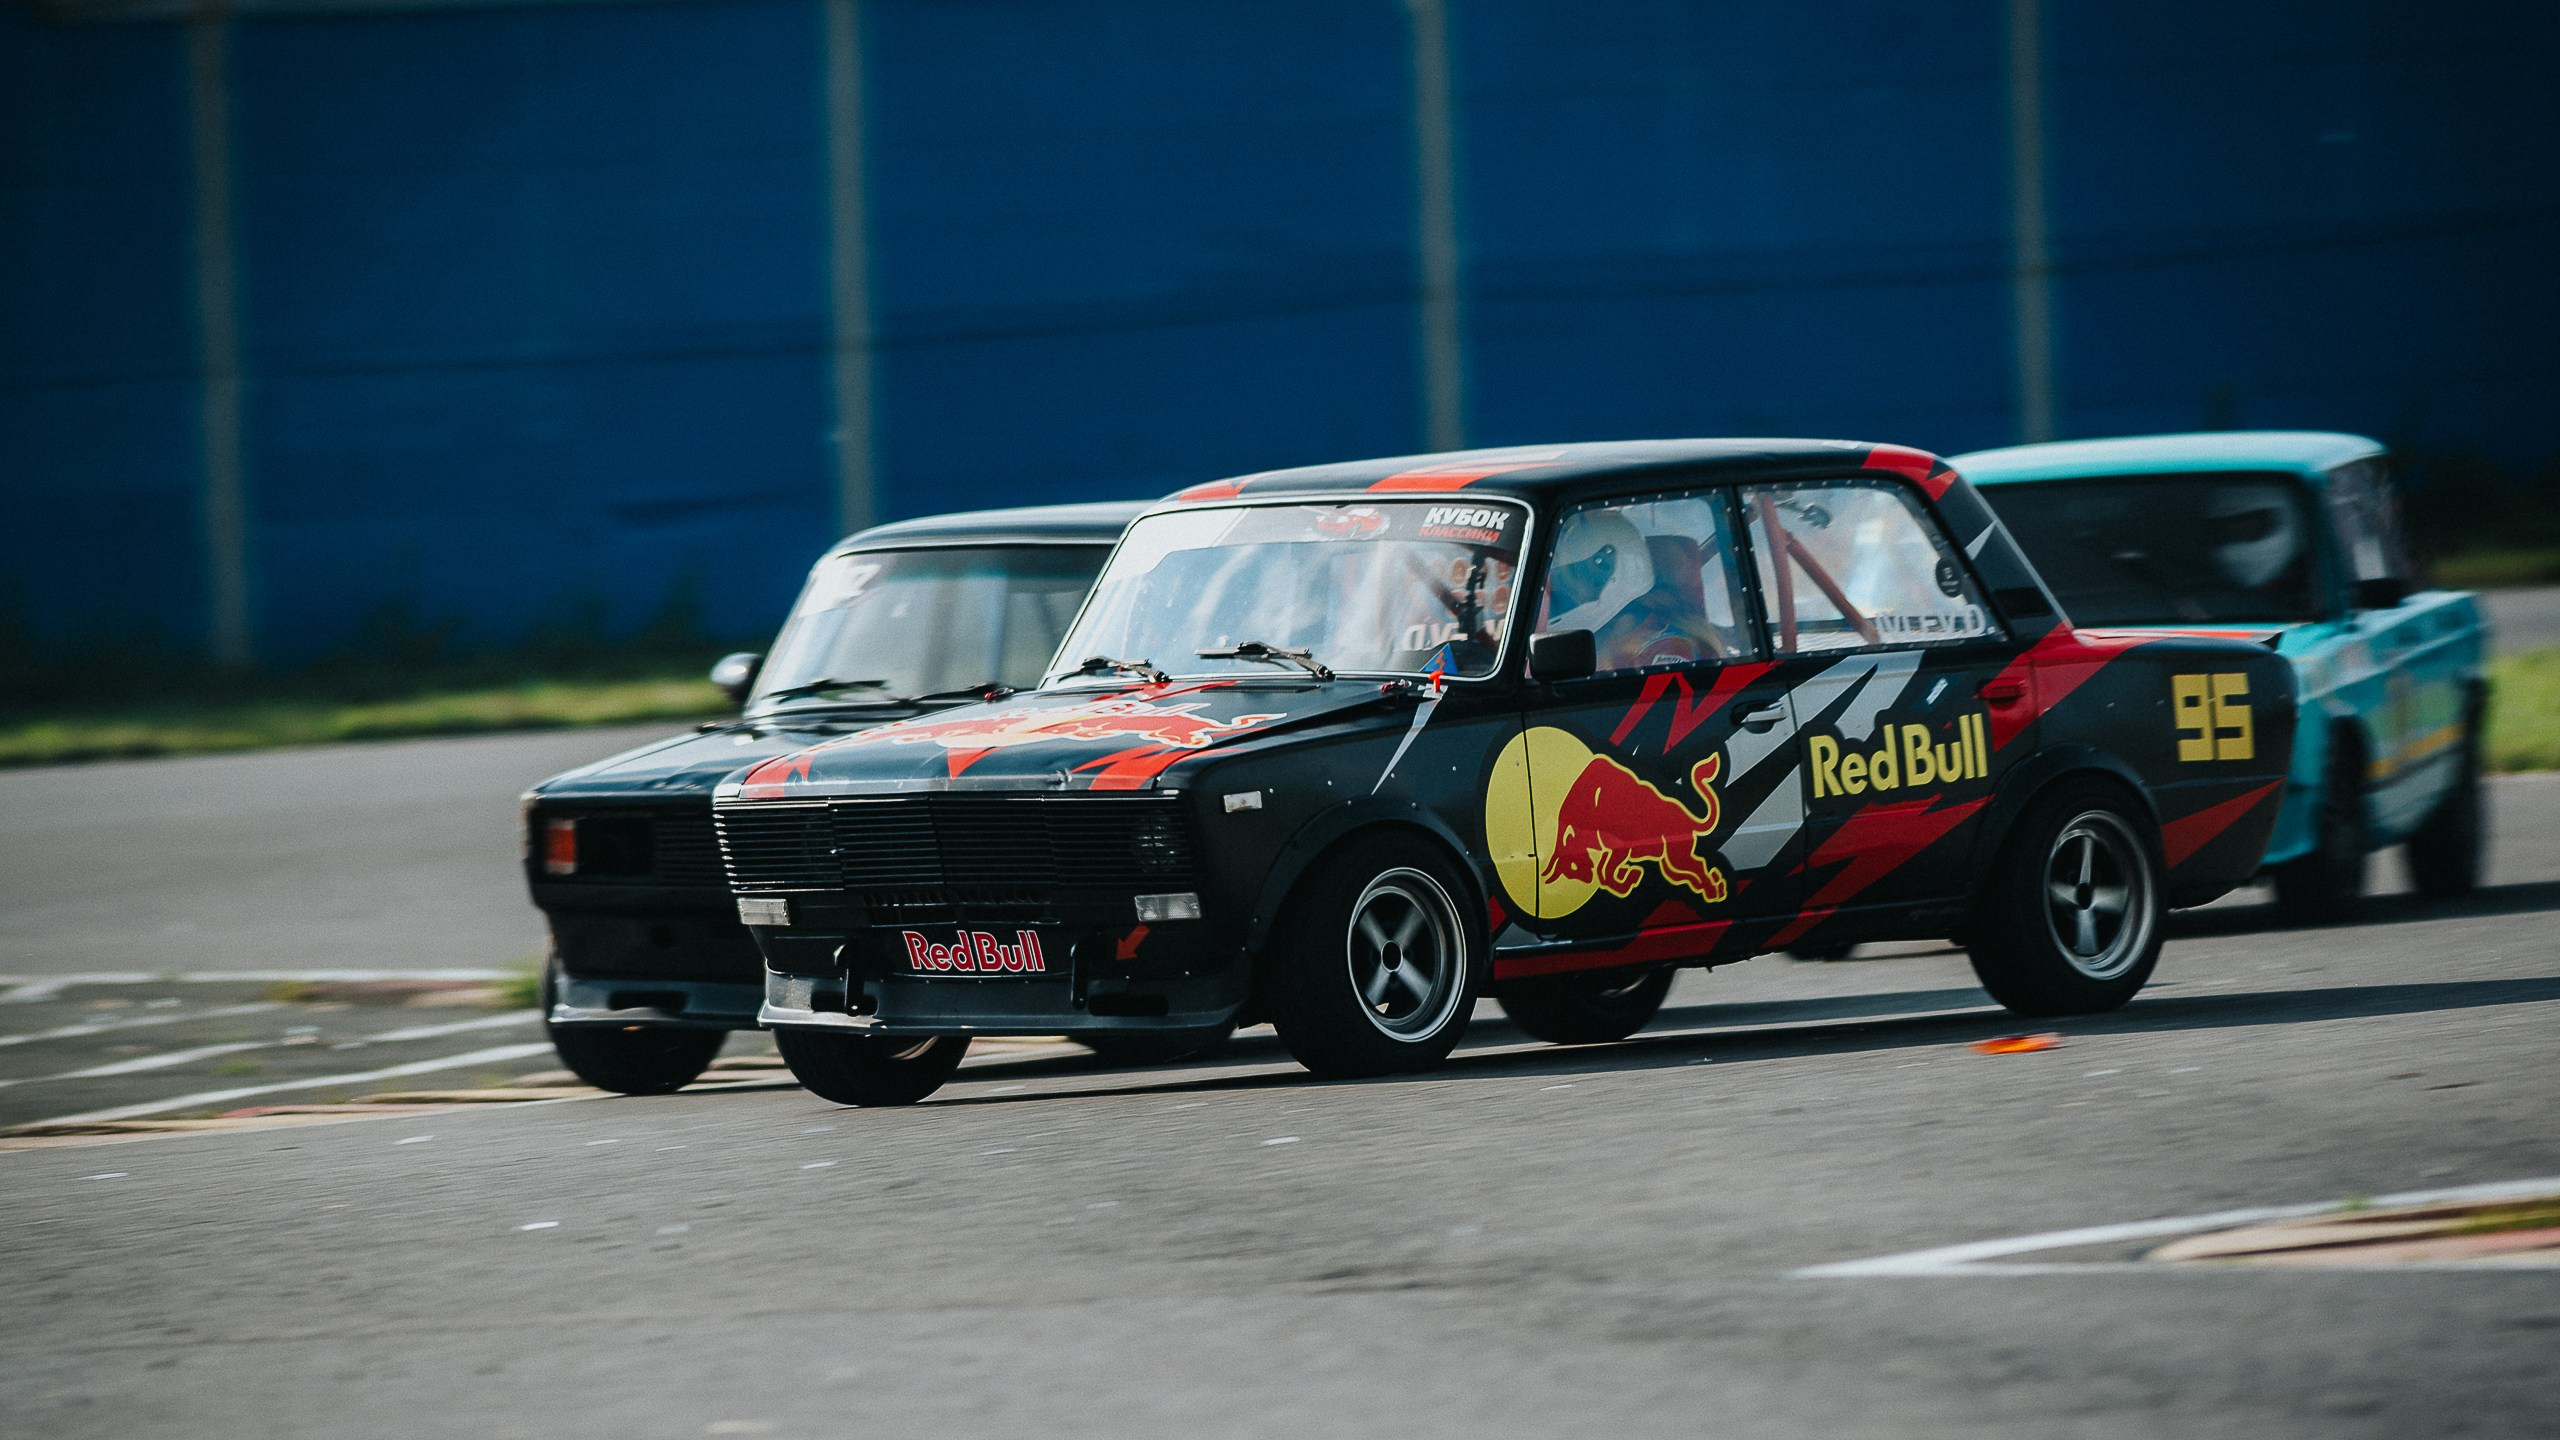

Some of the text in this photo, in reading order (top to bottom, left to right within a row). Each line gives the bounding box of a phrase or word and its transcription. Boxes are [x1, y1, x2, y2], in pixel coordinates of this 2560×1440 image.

[1419, 526, 1500, 543] КЛАССИКИ
[1423, 507, 1510, 530] КУБОК
[2171, 672, 2255, 762] 95
[1809, 713, 1988, 798] Red Bull
[902, 930, 1046, 972] Red Bull
